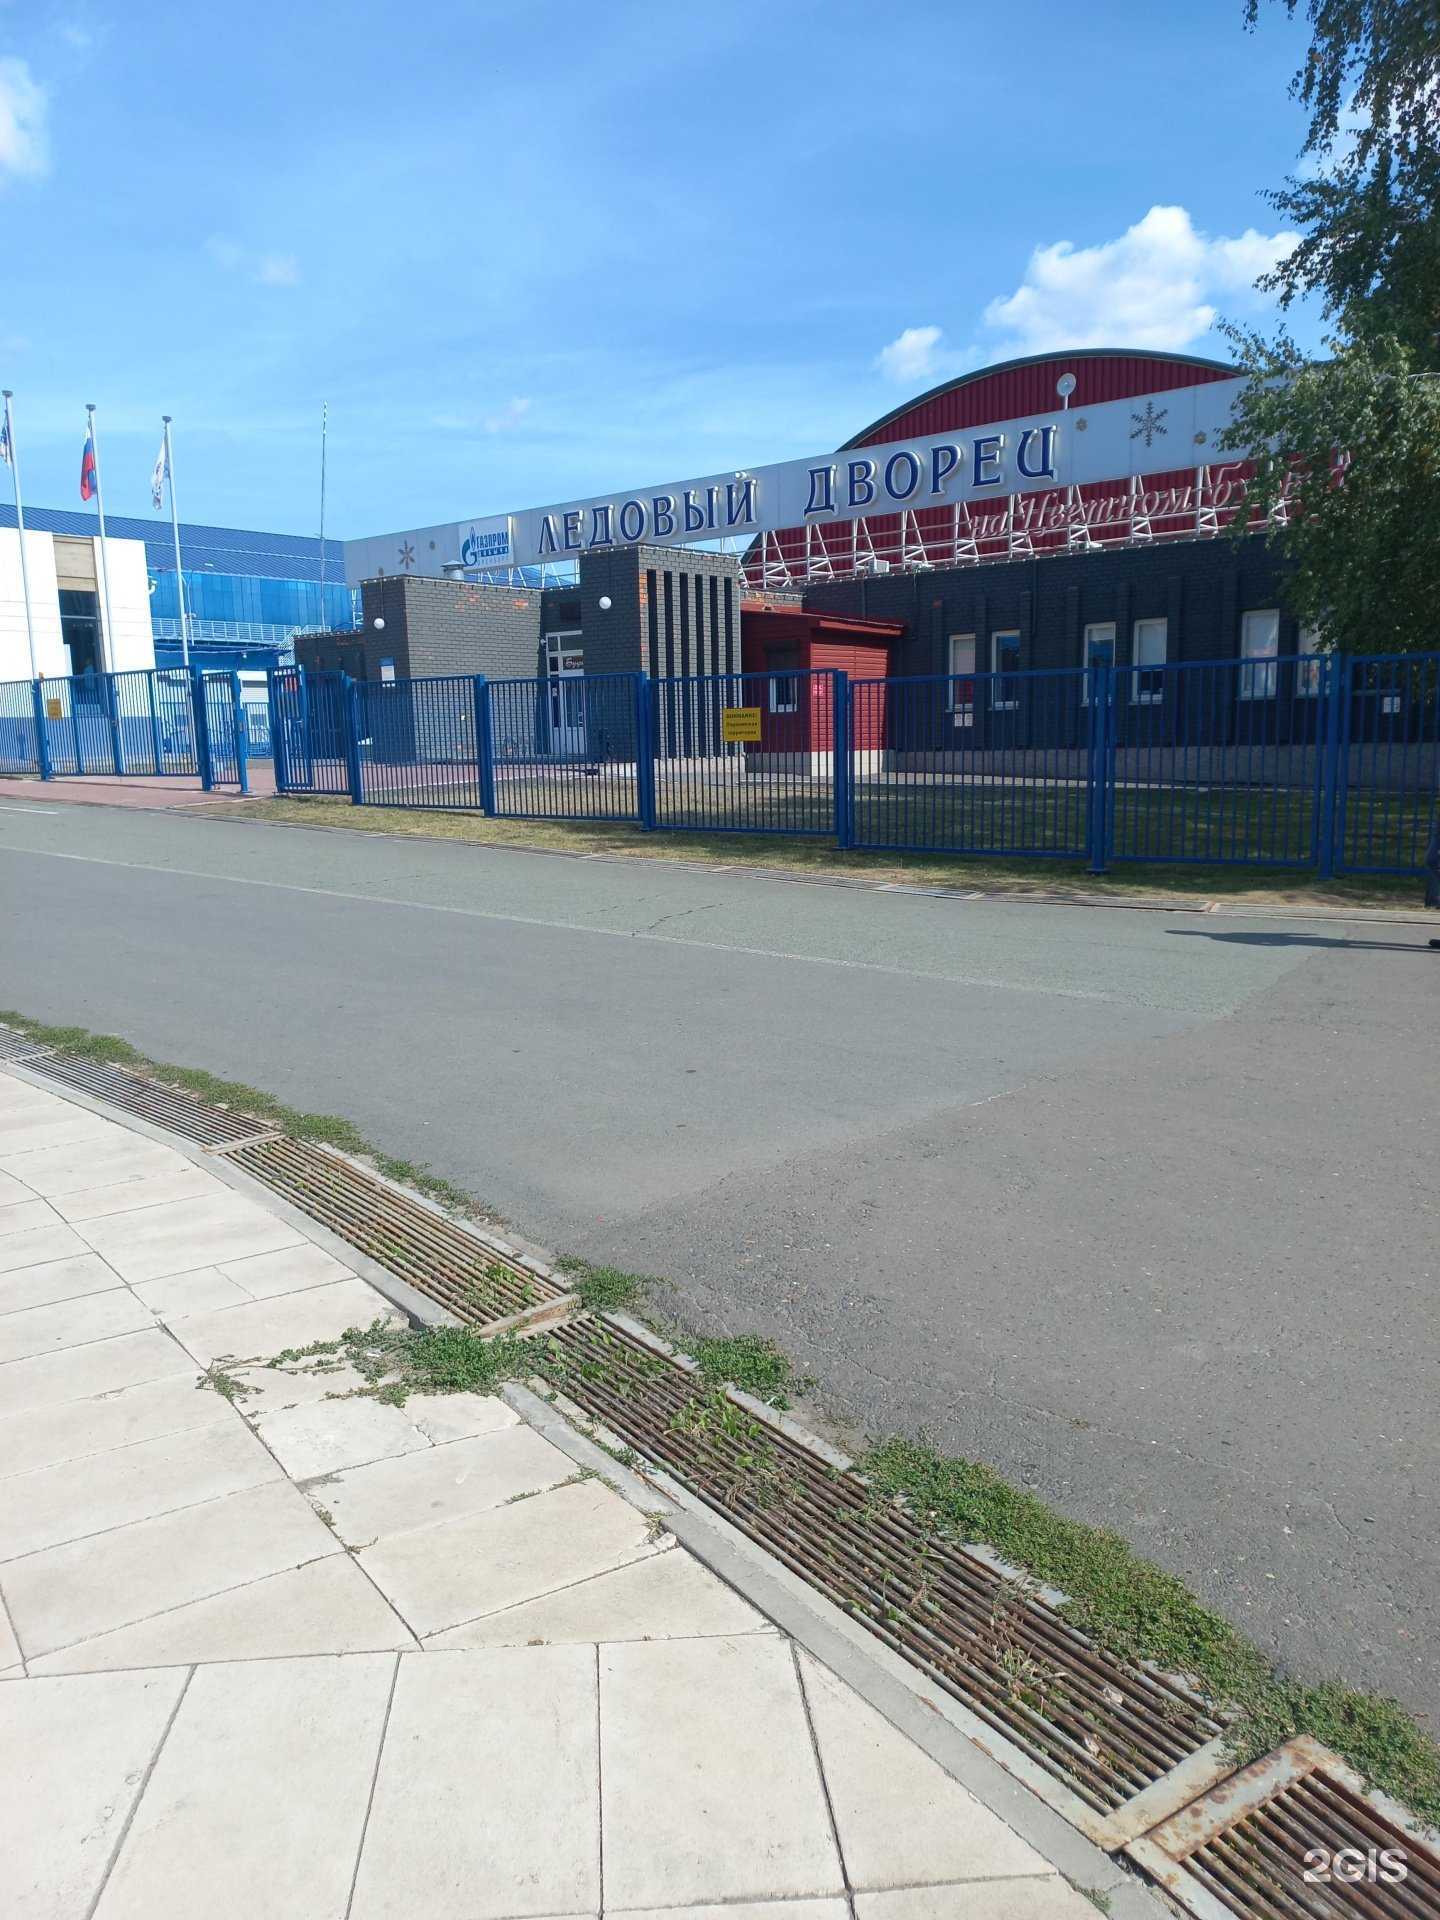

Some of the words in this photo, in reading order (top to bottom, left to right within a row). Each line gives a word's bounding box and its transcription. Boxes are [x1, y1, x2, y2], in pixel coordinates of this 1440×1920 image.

[538, 471, 758, 554] ЛЕДОВЫЙ
[803, 424, 1058, 518] ДВОРЕЦ
[476, 532, 508, 549] ГАЗПРОМ
